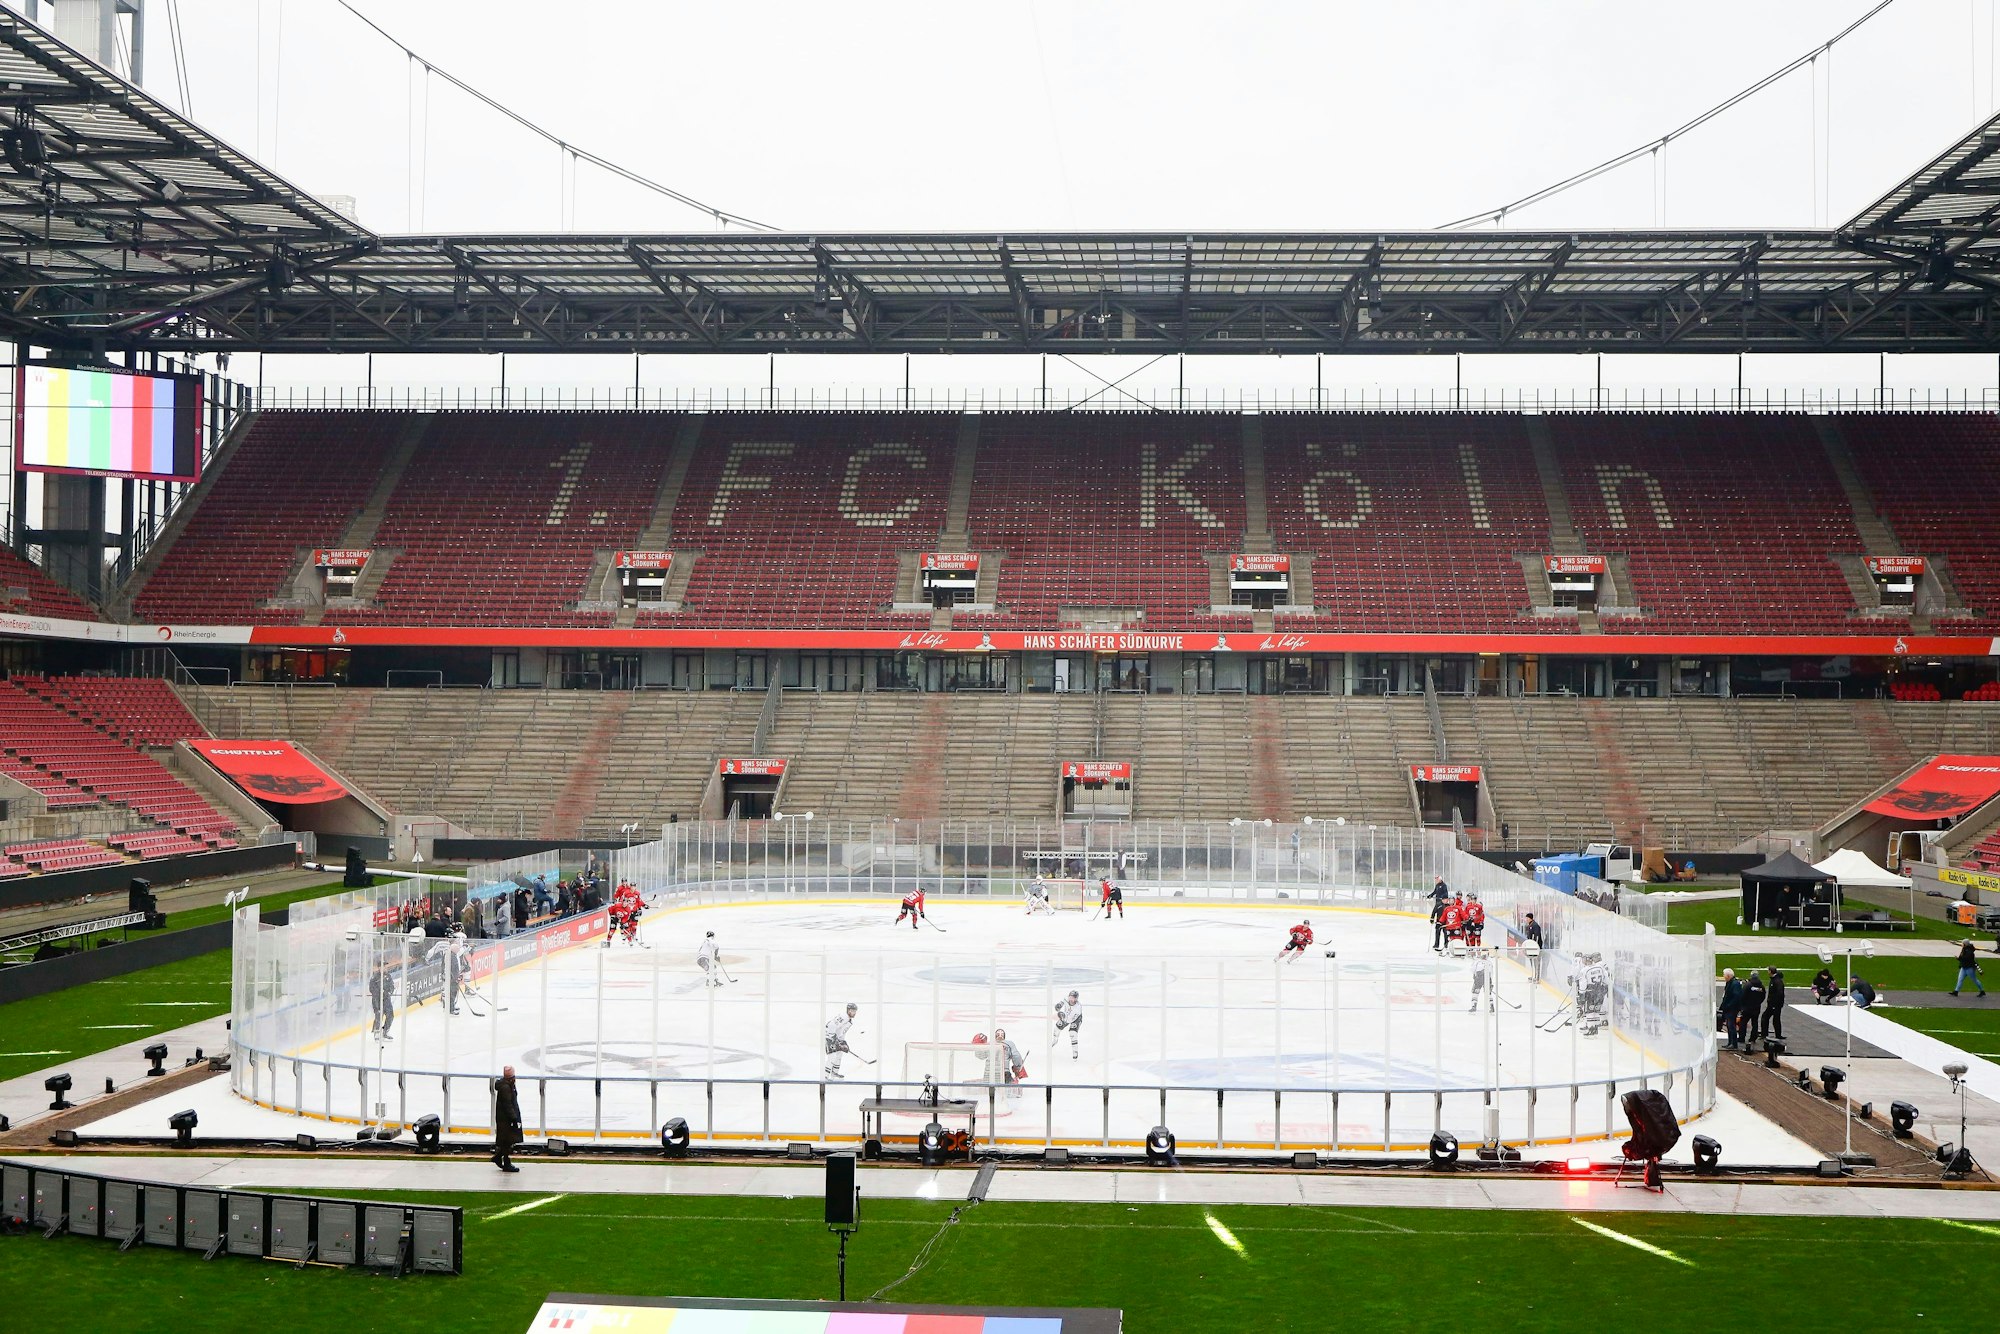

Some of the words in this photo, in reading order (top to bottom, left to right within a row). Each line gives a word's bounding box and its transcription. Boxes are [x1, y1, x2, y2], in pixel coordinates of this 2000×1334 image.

[648, 552, 672, 560] SCHÄFER
[174, 631, 216, 639] RheinEnergie
[1024, 635, 1056, 649] HANS
[1060, 633, 1114, 649] SCHÄFER
[1120, 634, 1183, 650] SÜDKURVE
[1099, 763, 1122, 771] SCHÄFER
[1536, 866, 1561, 874] evo
